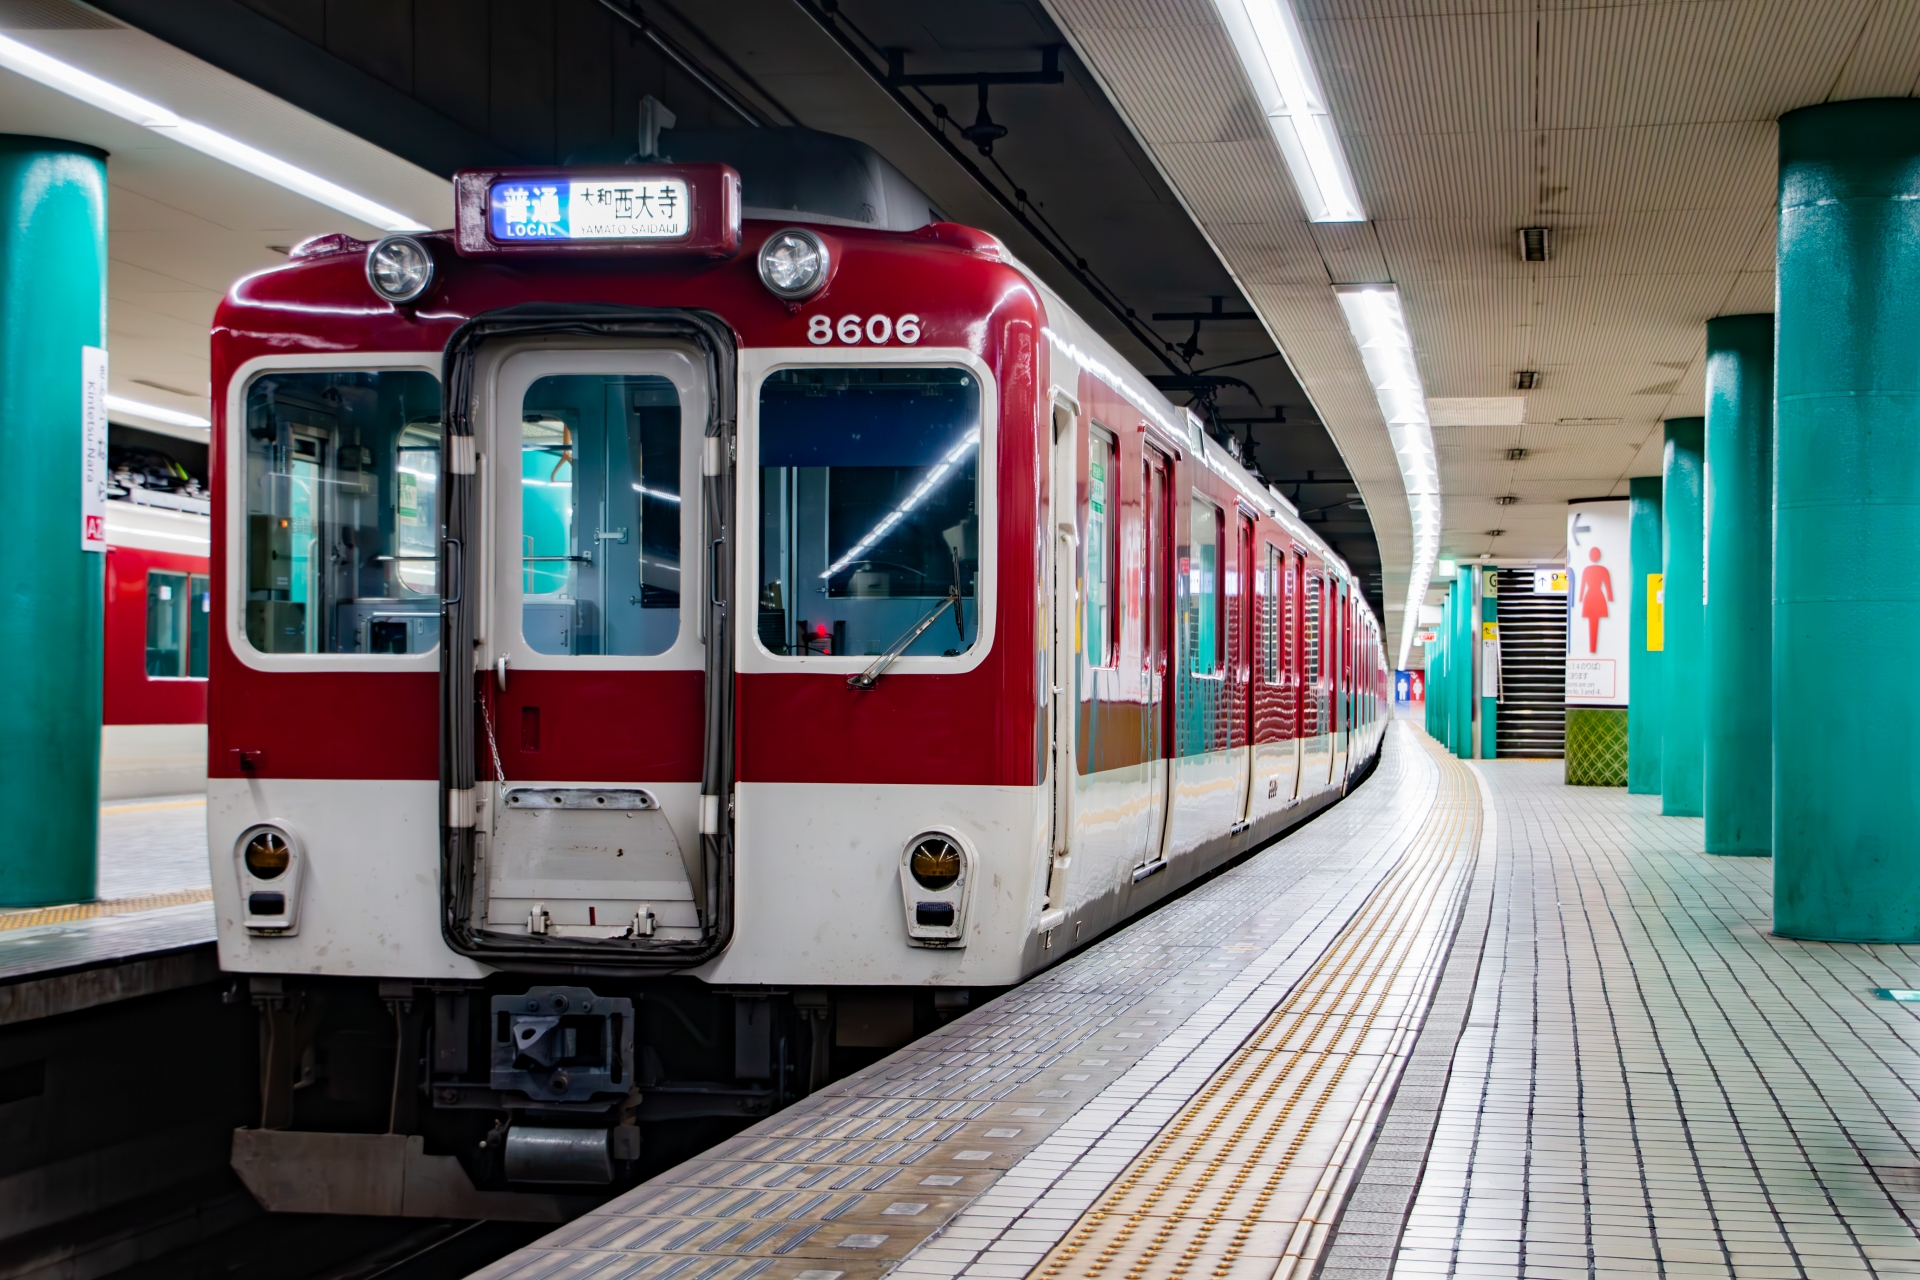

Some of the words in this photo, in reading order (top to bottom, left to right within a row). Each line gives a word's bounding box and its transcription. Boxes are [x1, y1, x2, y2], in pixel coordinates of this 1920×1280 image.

[503, 186, 561, 224] 普通
[580, 185, 678, 220] 大和西大寺
[507, 224, 556, 237] LOCAL
[580, 223, 627, 235] YAMATO
[631, 223, 678, 235] SAIDAIJI
[806, 313, 921, 345] 8606
[87, 381, 97, 483] Kintetsu-Nara
